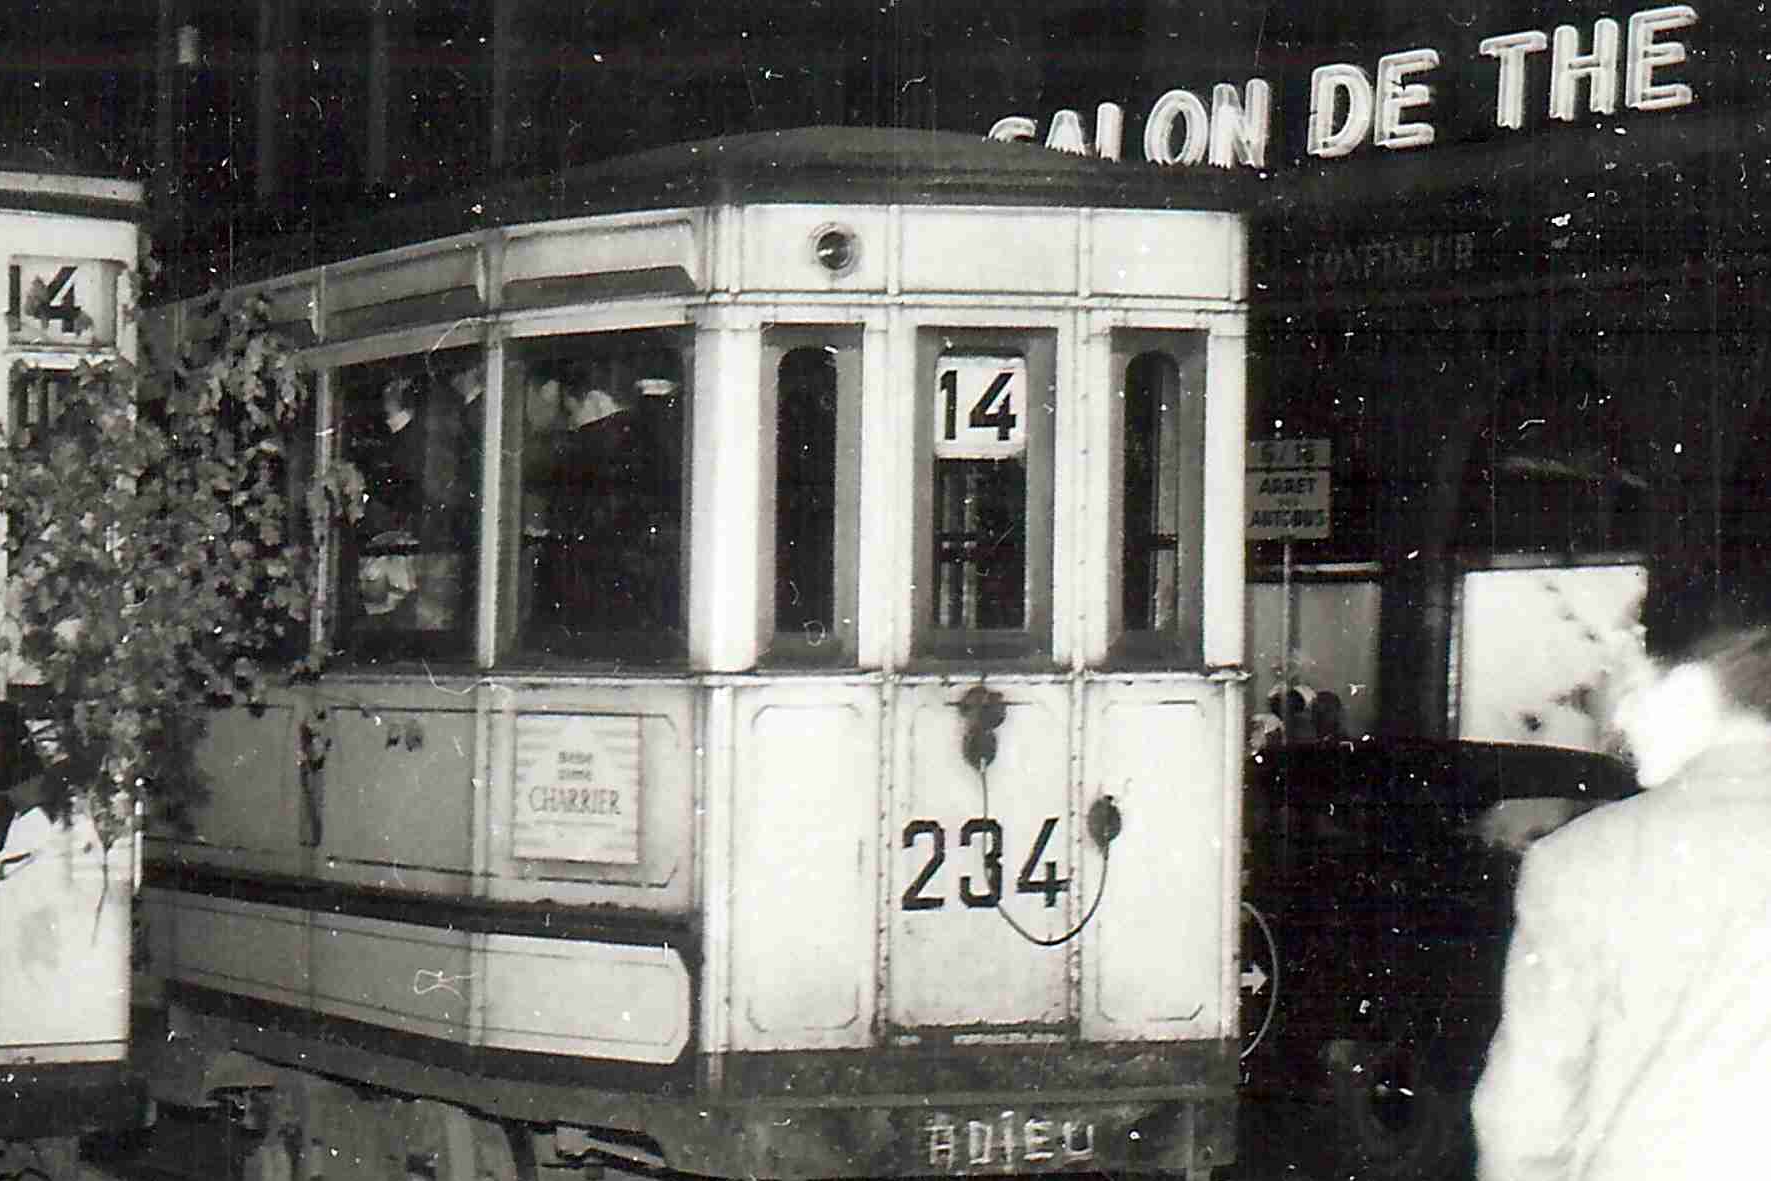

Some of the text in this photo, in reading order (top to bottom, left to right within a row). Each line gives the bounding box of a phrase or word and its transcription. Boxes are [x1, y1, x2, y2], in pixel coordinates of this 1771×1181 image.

[1307, 48, 1440, 159] DE
[1478, 4, 1699, 129] THE
[7, 264, 89, 333] 14
[940, 368, 1018, 442] 14
[528, 784, 622, 816] CHARRIER
[900, 816, 1071, 911] 234
[925, 1110, 1096, 1169] ADIEU
